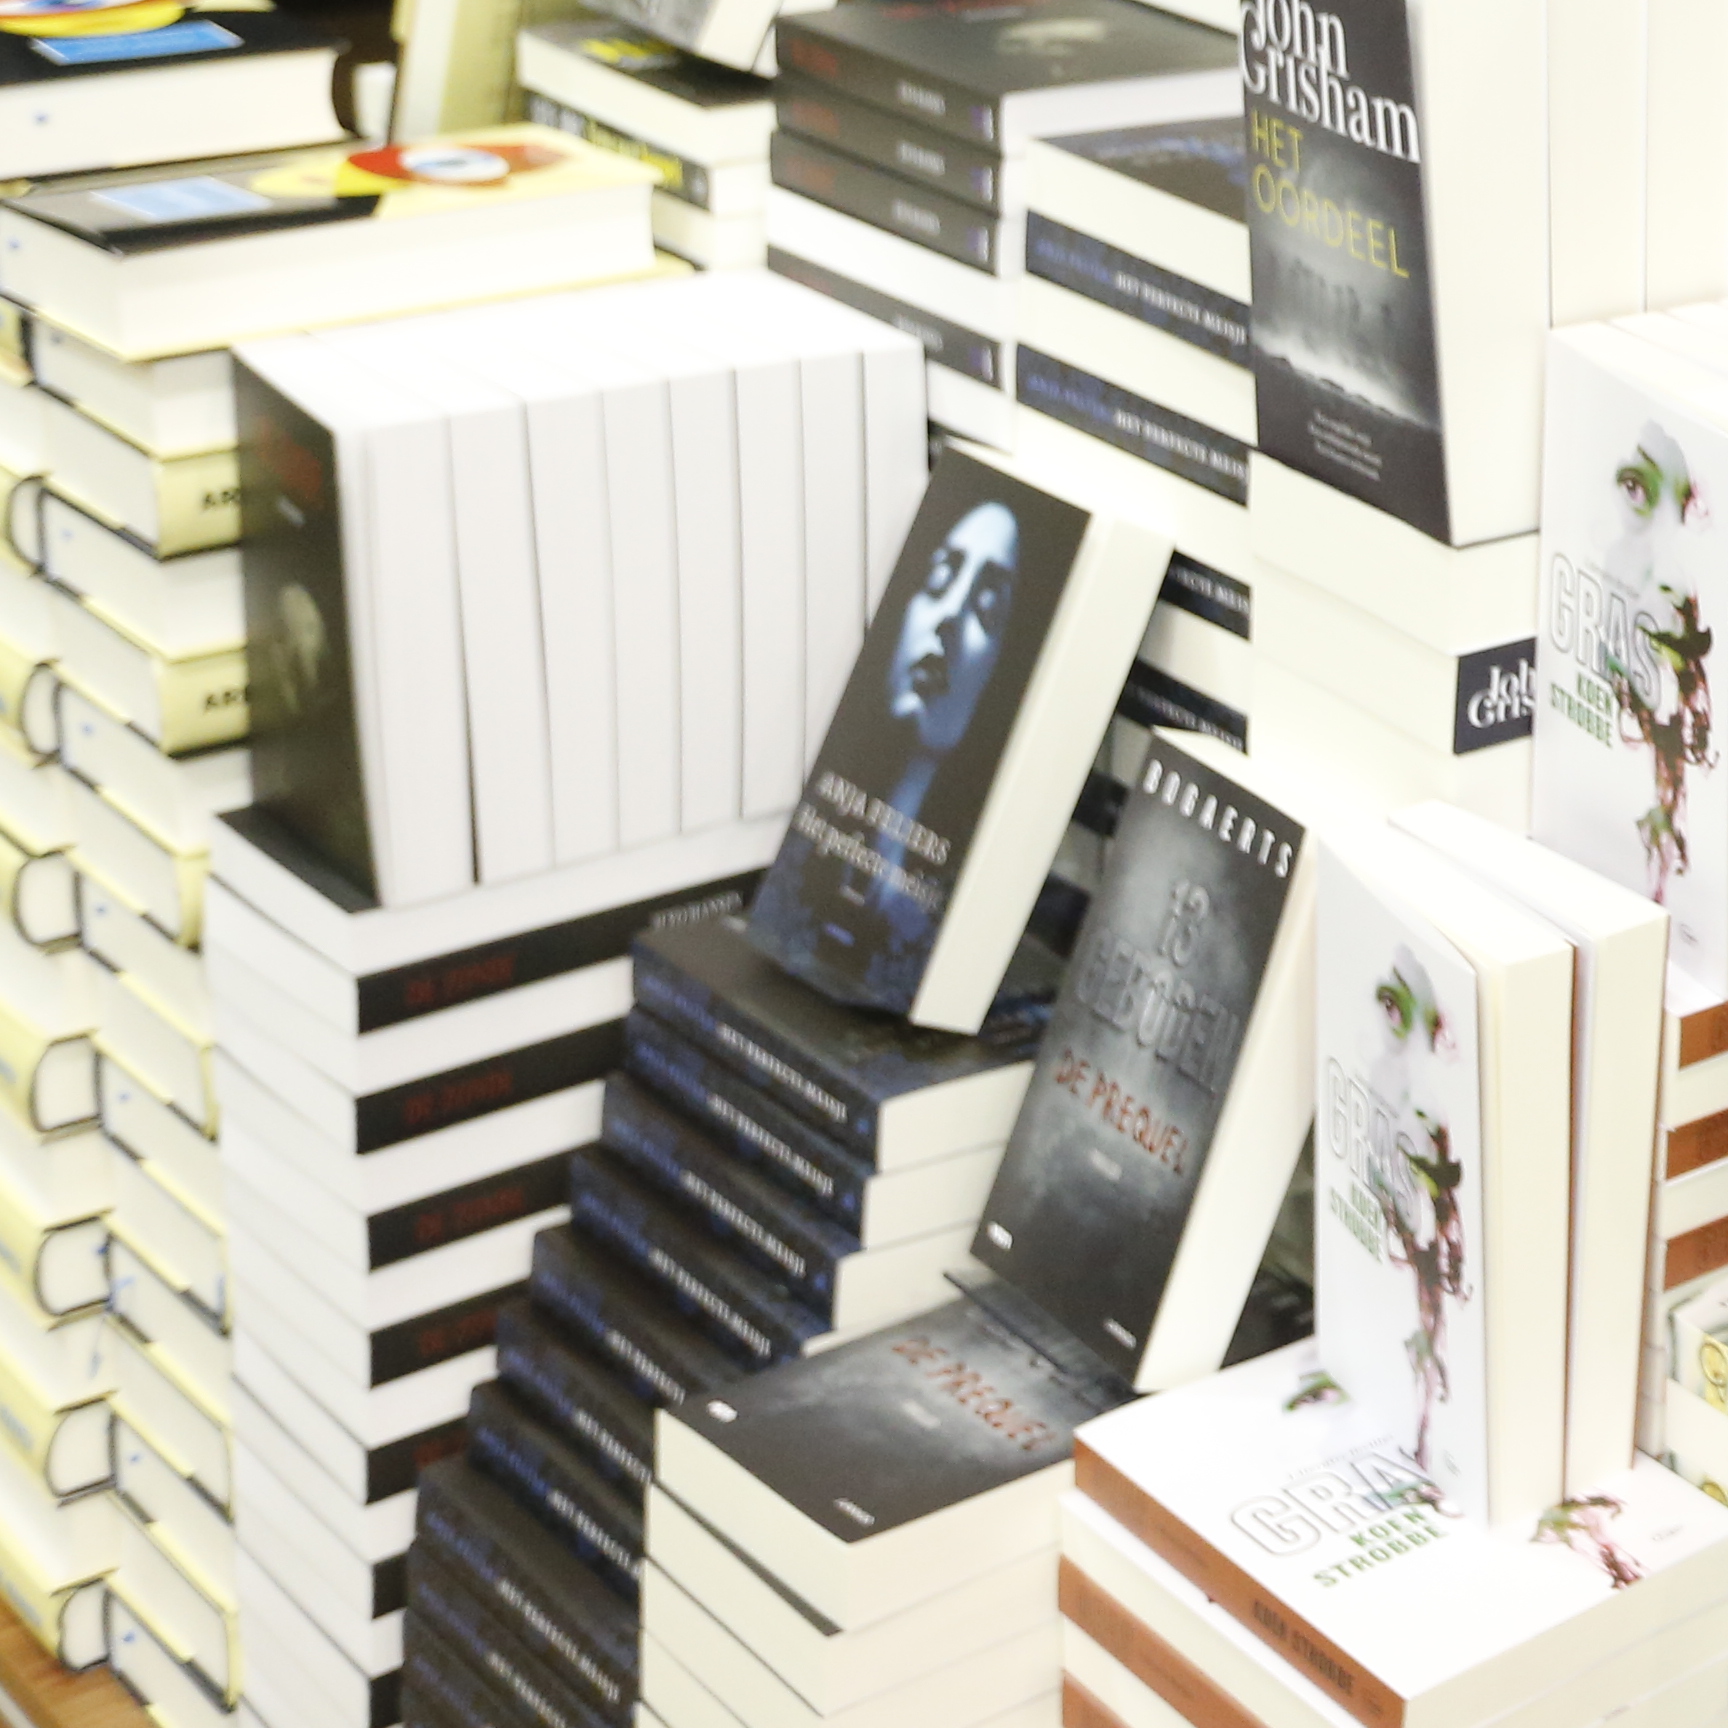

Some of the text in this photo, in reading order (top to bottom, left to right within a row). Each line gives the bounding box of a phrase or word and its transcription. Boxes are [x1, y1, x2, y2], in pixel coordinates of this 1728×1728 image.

[1239, 0, 1422, 164] Grisham
[1251, 108, 1304, 172] HET
[1251, 165, 1410, 280] OORDEEL
[1550, 549, 1662, 716] GRAS
[1550, 681, 1615, 749] STROBBE
[814, 771, 951, 866] ANJA FELIERS
[1142, 757, 1294, 879] BOGAERTS
[1053, 1046, 1091, 1098] DE
[1088, 1069, 1191, 1175] PREQUEL
[1327, 1055, 1422, 1234] GRAS
[1312, 1521, 1448, 1589] STROBBE
[1349, 1504, 1428, 1548] KOEN
